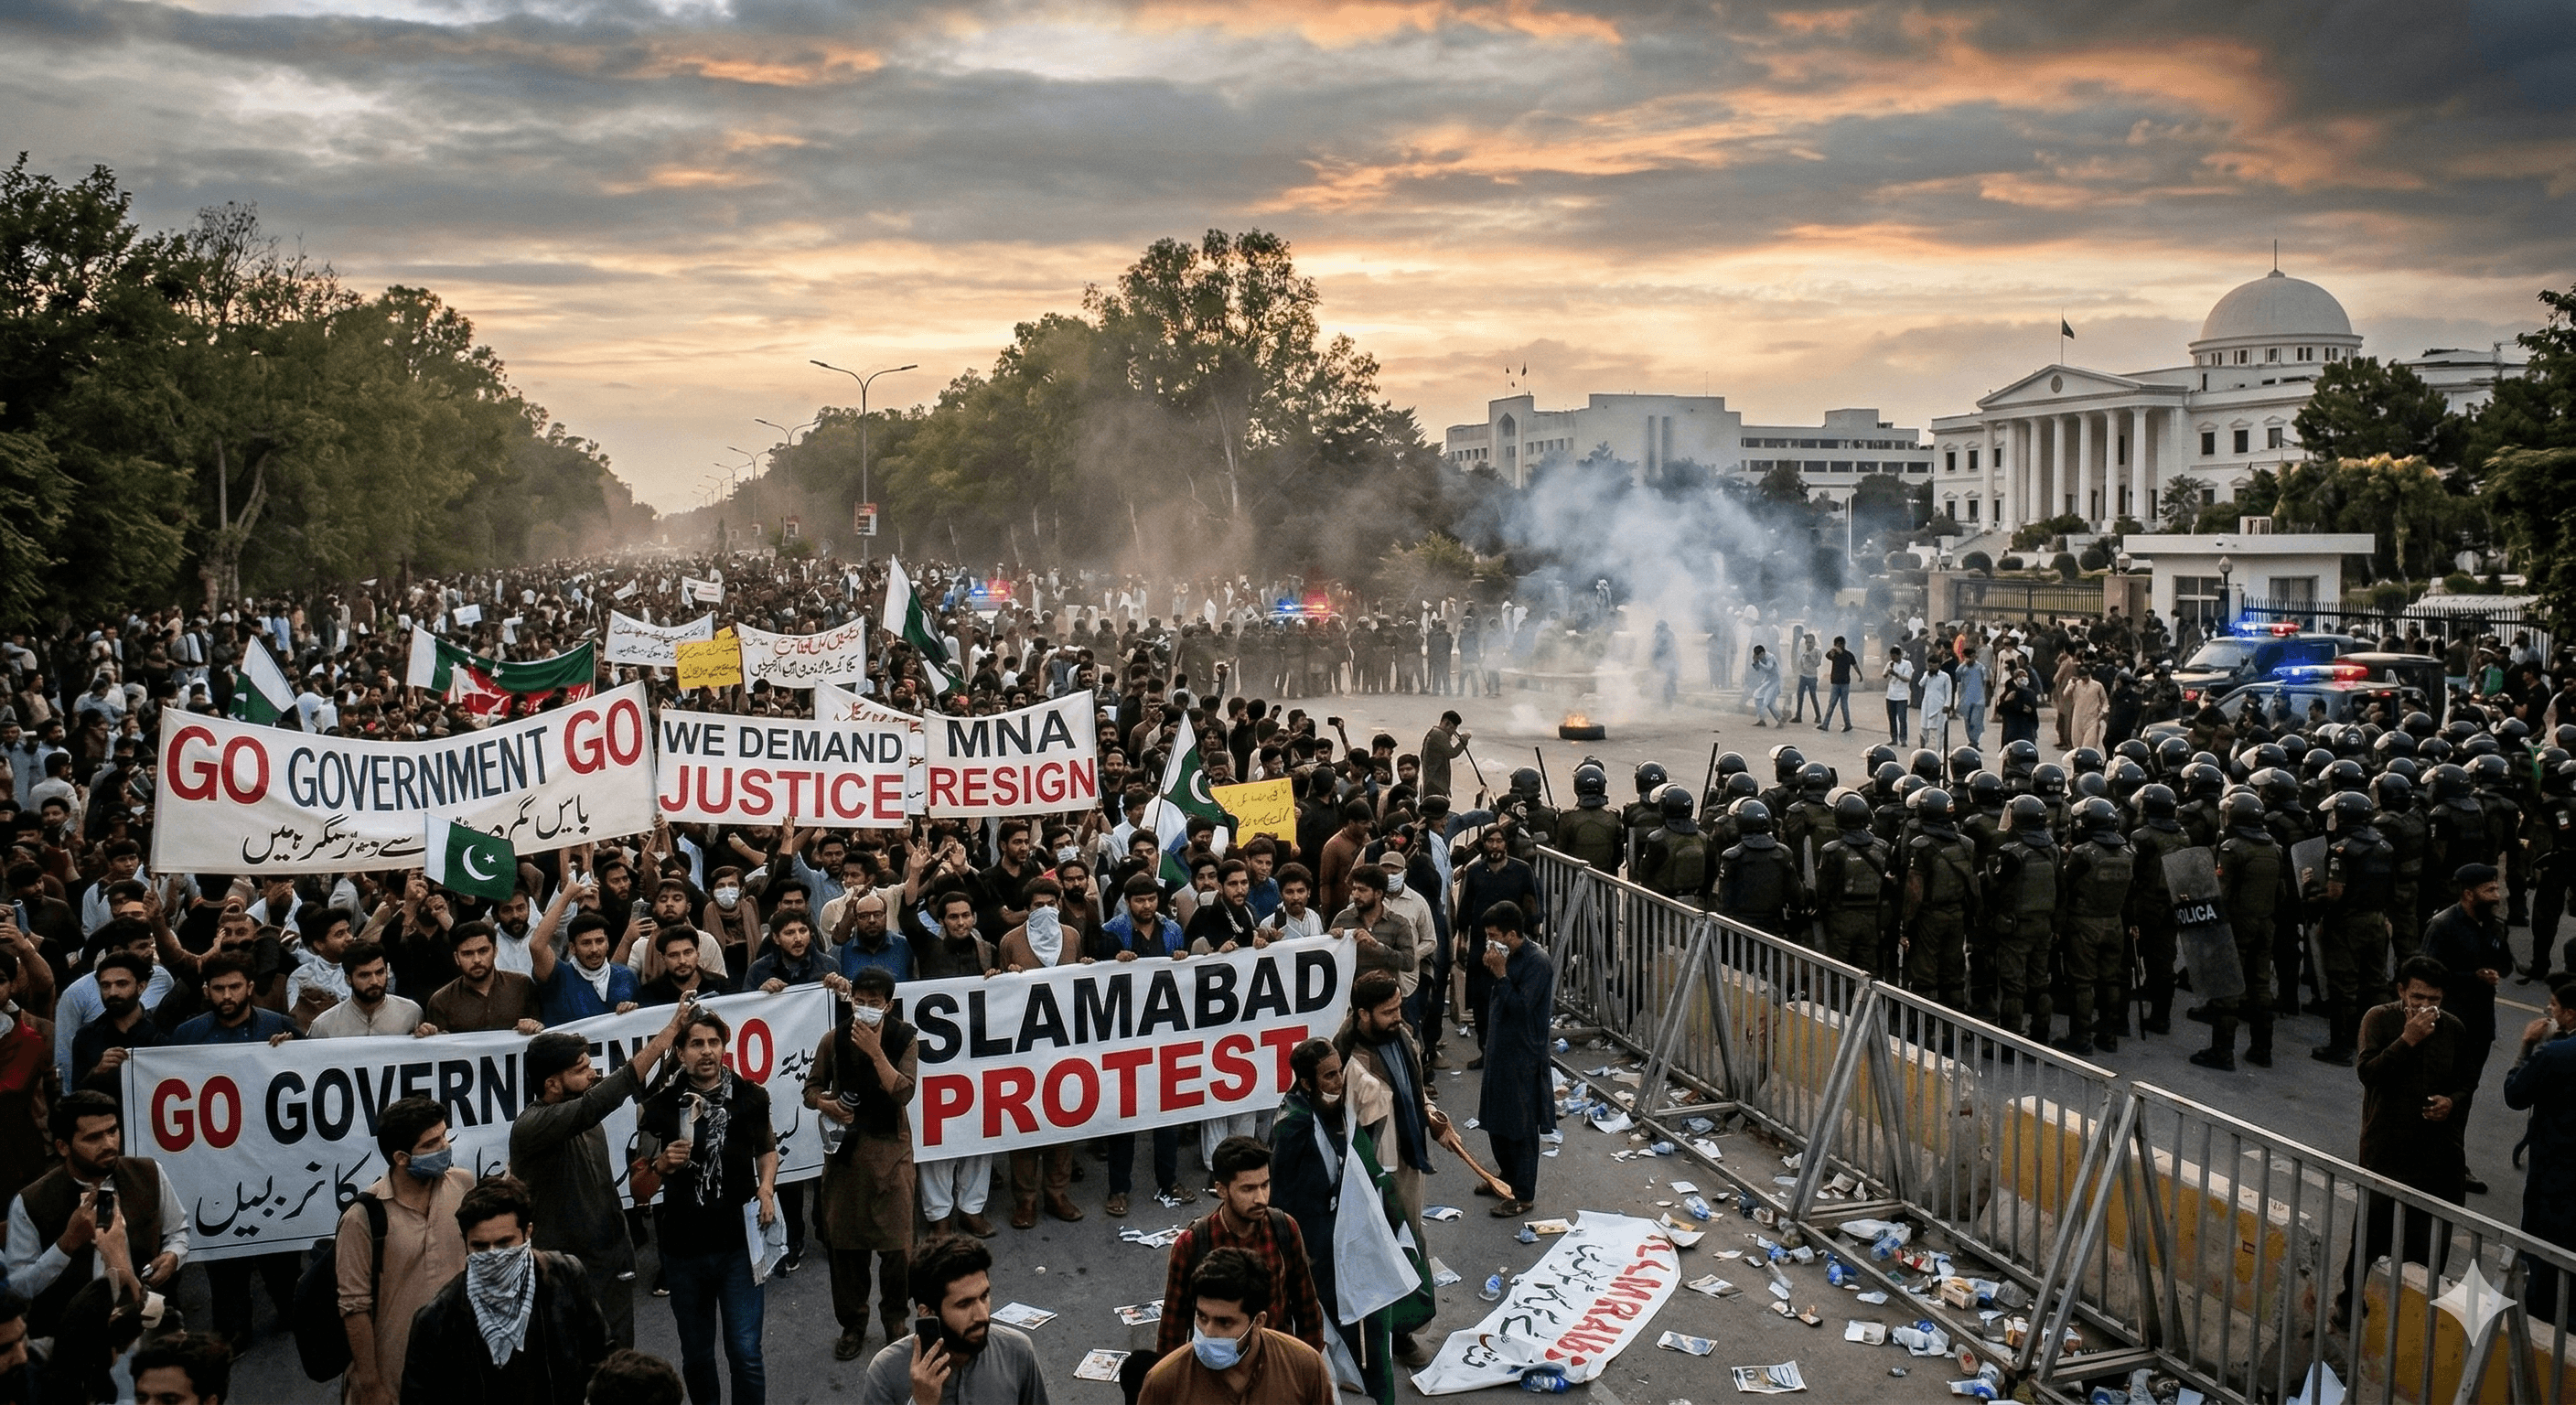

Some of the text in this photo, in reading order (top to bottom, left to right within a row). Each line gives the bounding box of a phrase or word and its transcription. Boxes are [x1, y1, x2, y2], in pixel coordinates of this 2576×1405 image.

[166, 698, 643, 811] GO GOVERNMENT GO
[664, 720, 903, 764] WE DEMAND
[947, 709, 1076, 758] MNA
[660, 766, 905, 820] JUSTICE
[928, 757, 1096, 807] RESIGN
[2174, 904, 2217, 925] OLICA
[893, 949, 1338, 1064] SLAMABAD
[922, 1025, 1309, 1148] PROTEST
[151, 1075, 242, 1153] GO
